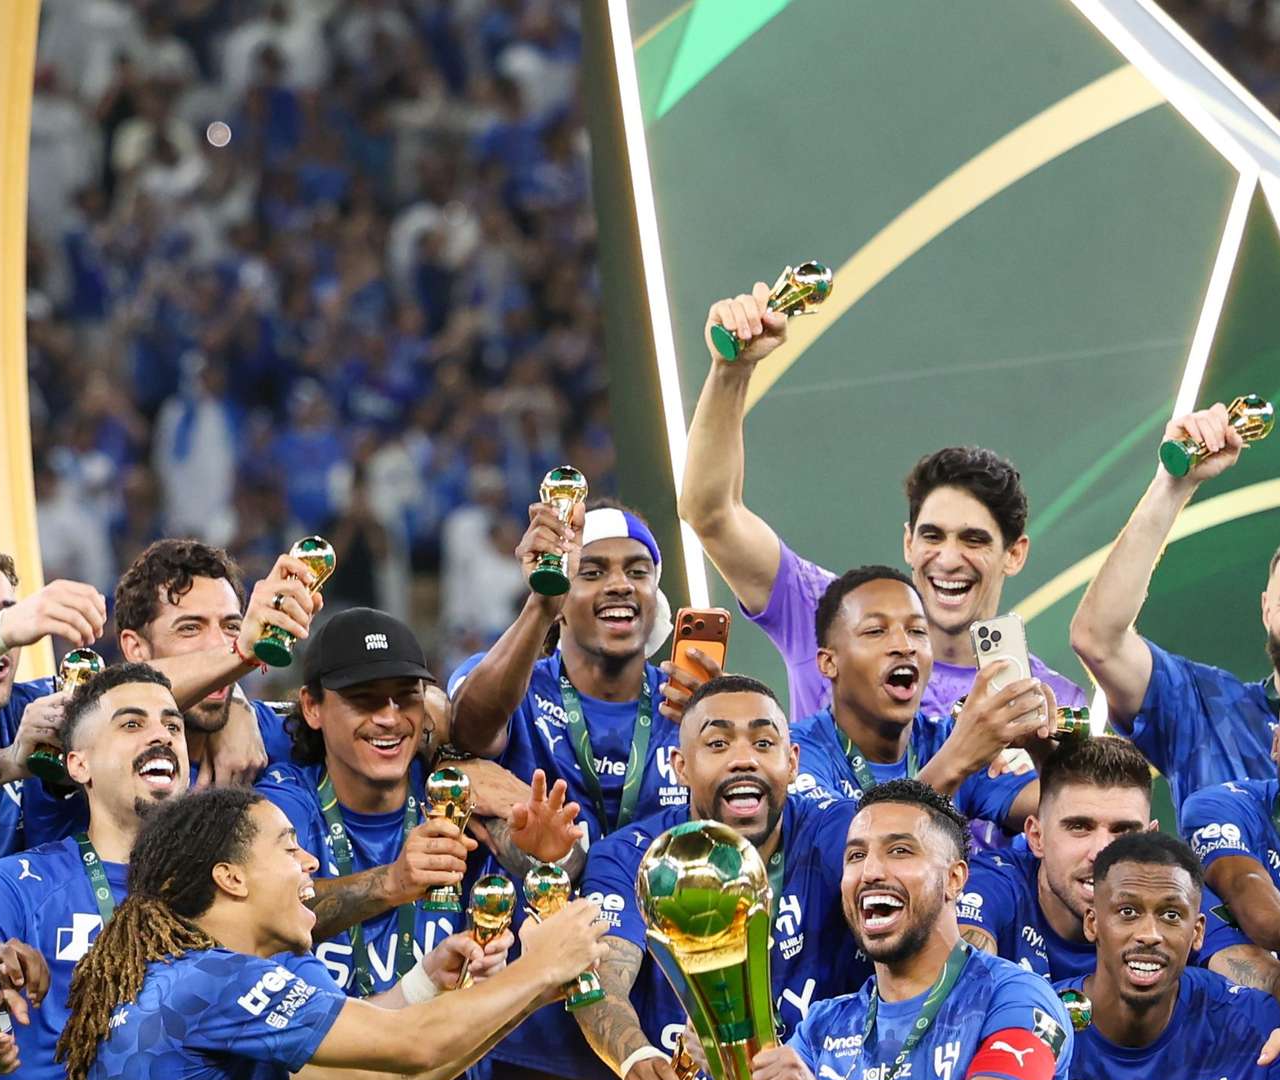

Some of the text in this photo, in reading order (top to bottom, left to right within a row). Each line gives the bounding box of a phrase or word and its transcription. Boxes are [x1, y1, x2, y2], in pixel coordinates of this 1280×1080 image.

[535, 694, 568, 723] ynas
[594, 756, 628, 776] ahe
[823, 1035, 863, 1052] lynas
